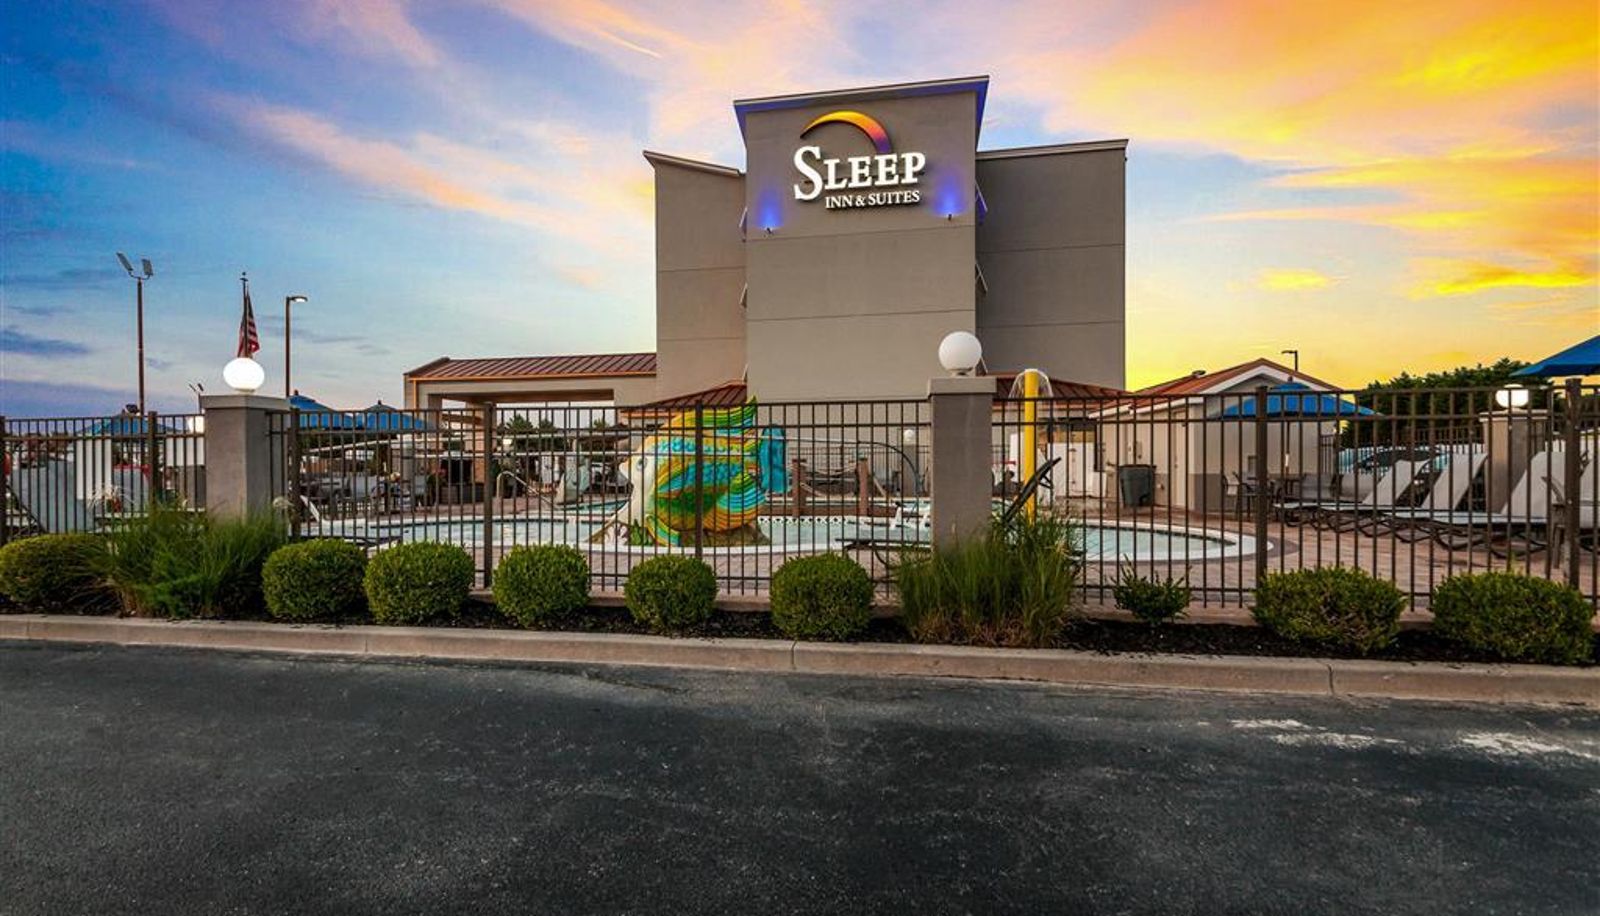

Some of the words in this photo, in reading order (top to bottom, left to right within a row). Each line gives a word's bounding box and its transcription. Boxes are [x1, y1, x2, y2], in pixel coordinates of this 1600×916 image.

[793, 145, 926, 200] SLEEP
[825, 195, 853, 209] INN
[855, 195, 866, 207] &
[868, 190, 920, 205] SUITES
